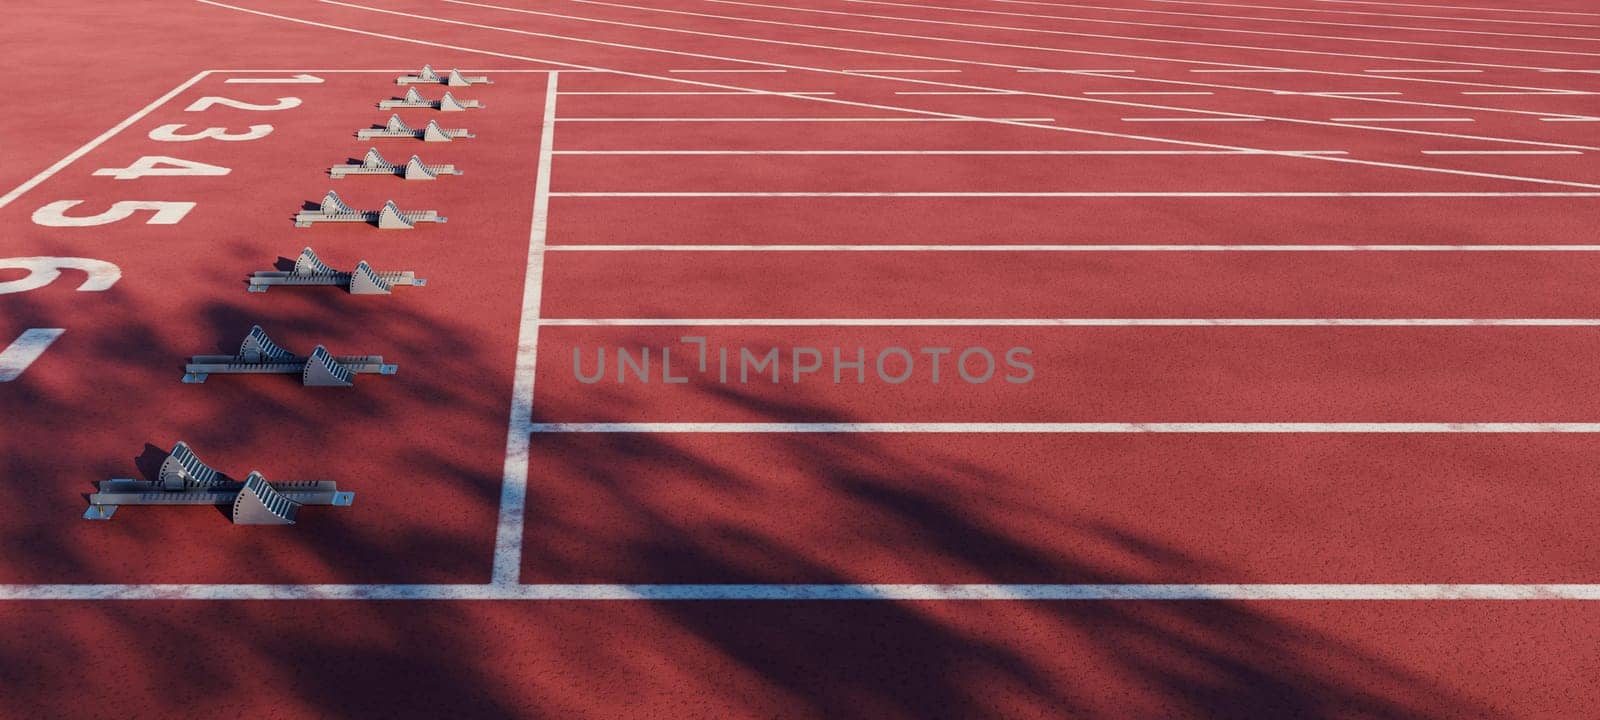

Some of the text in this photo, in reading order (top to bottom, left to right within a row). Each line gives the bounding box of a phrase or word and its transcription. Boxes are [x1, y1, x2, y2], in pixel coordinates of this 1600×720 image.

[224, 74, 324, 83] 1
[184, 96, 302, 111] 2
[148, 124, 274, 141] 3
[91, 156, 232, 179] 4
[31, 200, 197, 226] 5
[0, 256, 122, 294] 6
